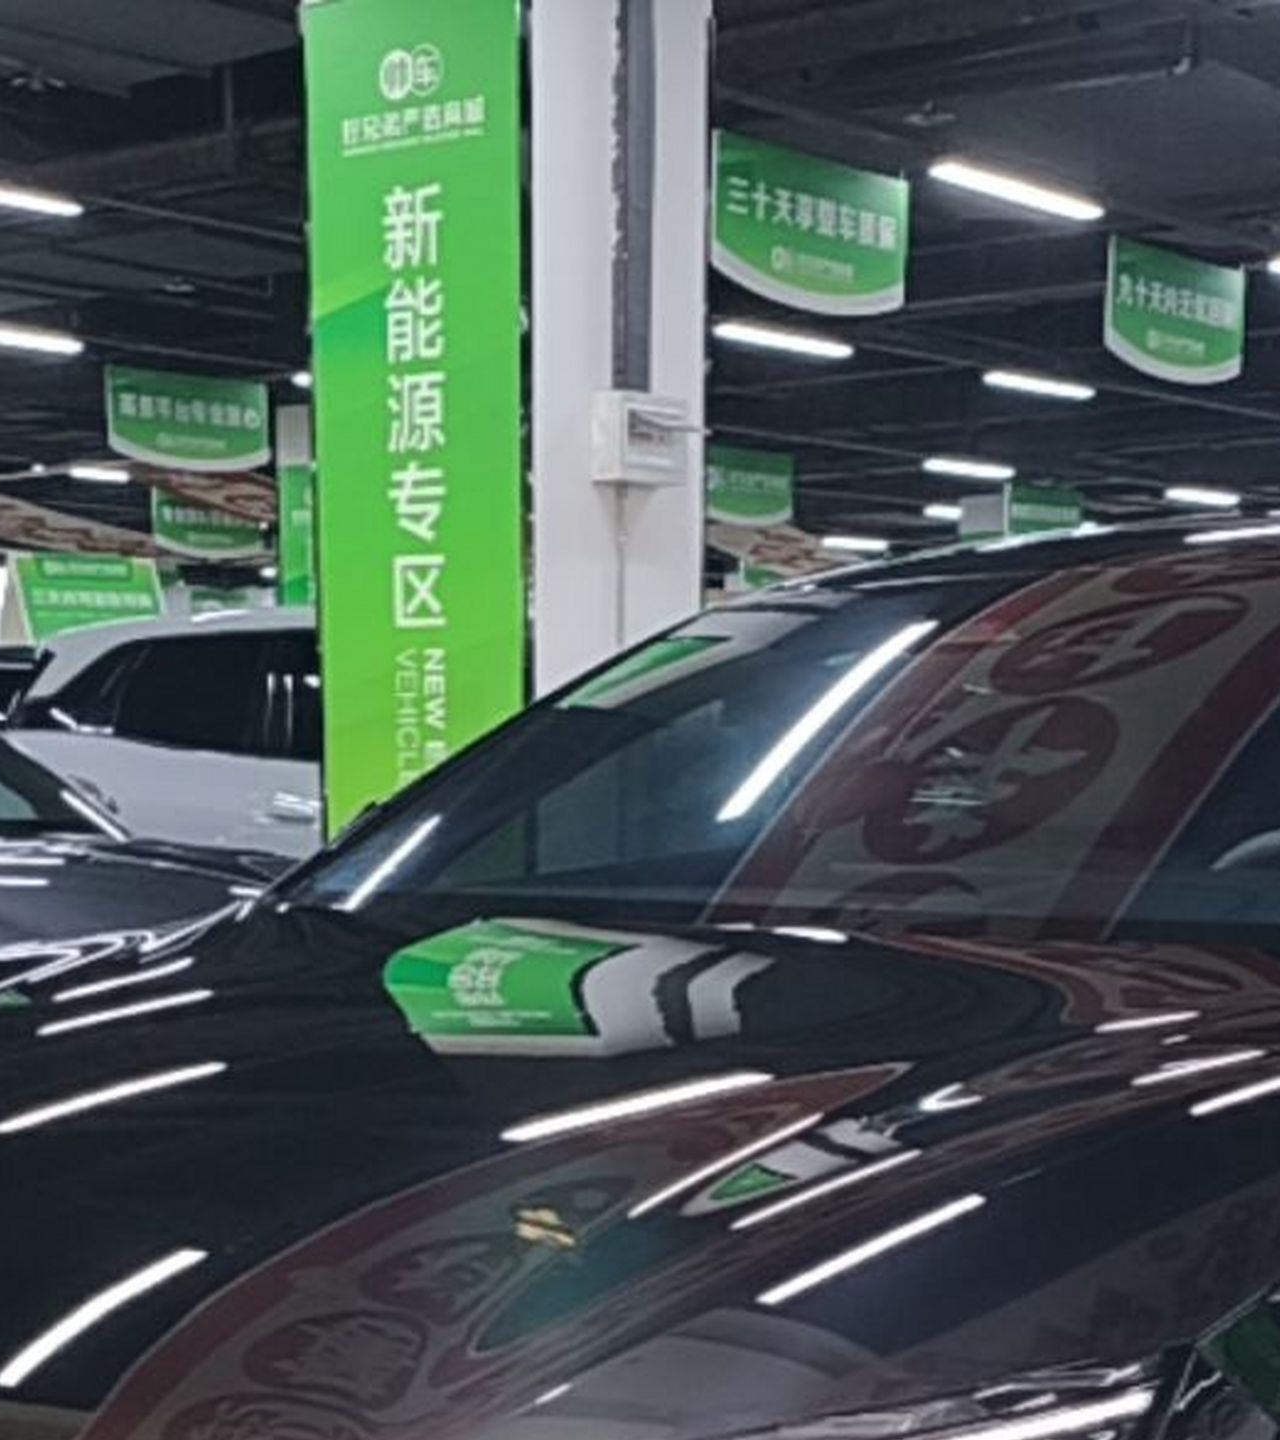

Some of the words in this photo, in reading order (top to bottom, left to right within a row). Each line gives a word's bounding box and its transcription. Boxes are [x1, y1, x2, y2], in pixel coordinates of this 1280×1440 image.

[381, 183, 448, 630] 新能源专区
[422, 648, 446, 730] NEW
